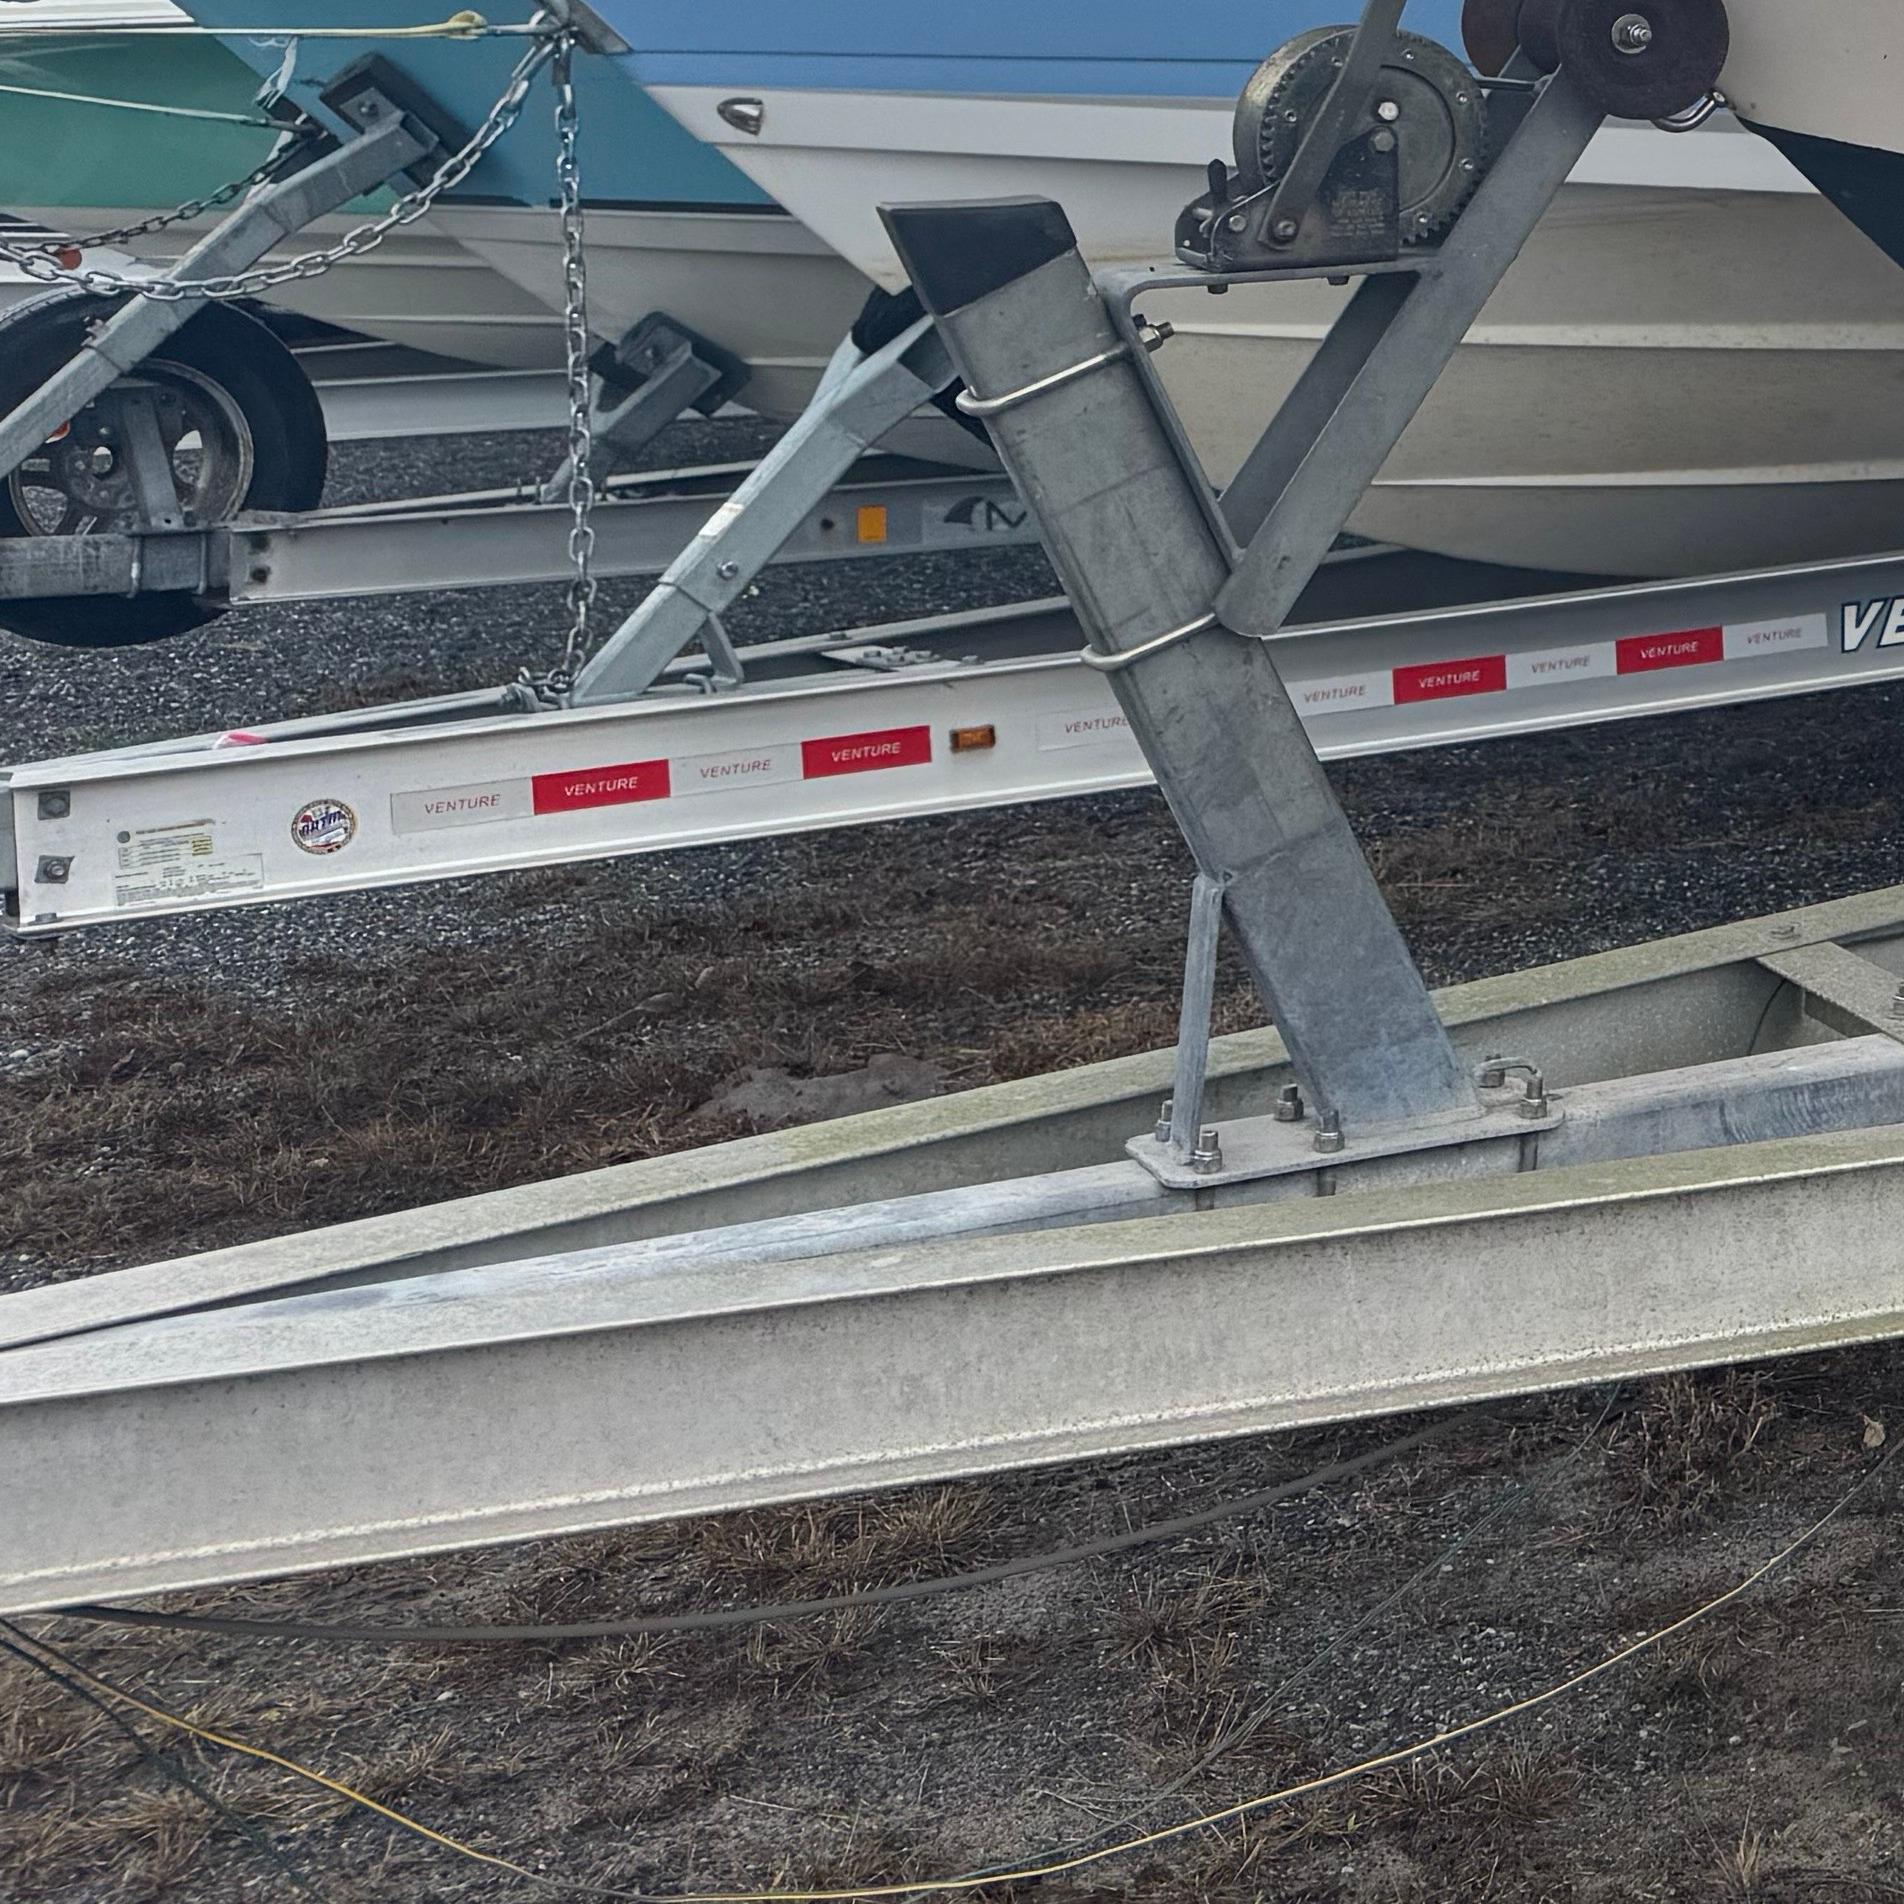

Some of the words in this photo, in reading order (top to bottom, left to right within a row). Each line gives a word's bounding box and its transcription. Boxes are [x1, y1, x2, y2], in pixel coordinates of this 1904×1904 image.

[1746, 627, 1803, 646] VENTURE
[1639, 640, 1700, 660] VENTURE
[1531, 655, 1592, 675] VENTURE
[1417, 669, 1481, 690] VENTURE
[1303, 684, 1367, 704] VENTURE
[830, 741, 902, 763] VENTURE
[699, 758, 773, 780] VENTURE
[563, 775, 638, 798] VENTURE
[423, 793, 502, 815] VENTURE
